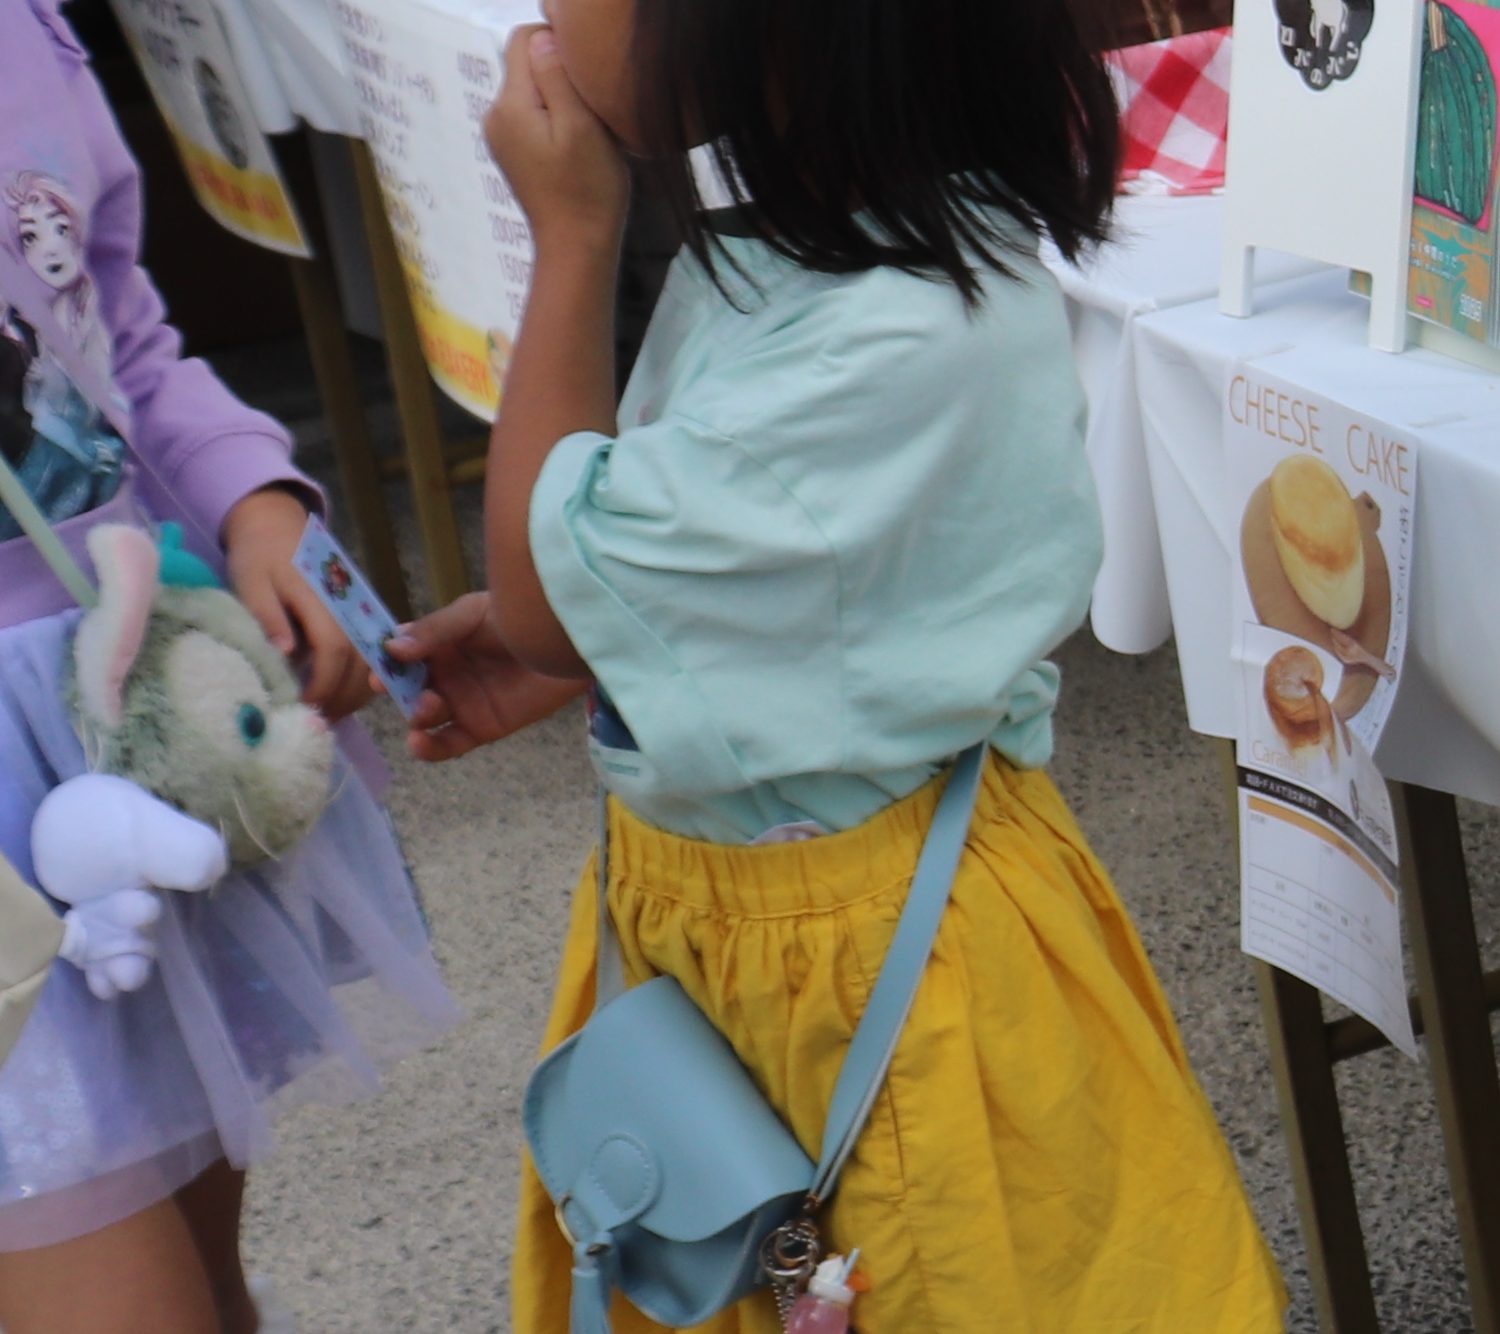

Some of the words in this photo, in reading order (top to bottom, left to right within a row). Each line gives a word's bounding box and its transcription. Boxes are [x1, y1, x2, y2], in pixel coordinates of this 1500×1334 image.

[1277, 22, 1362, 86] ロバのパン
[1228, 374, 1324, 457] CHEESE
[1346, 422, 1410, 498] CAKE
